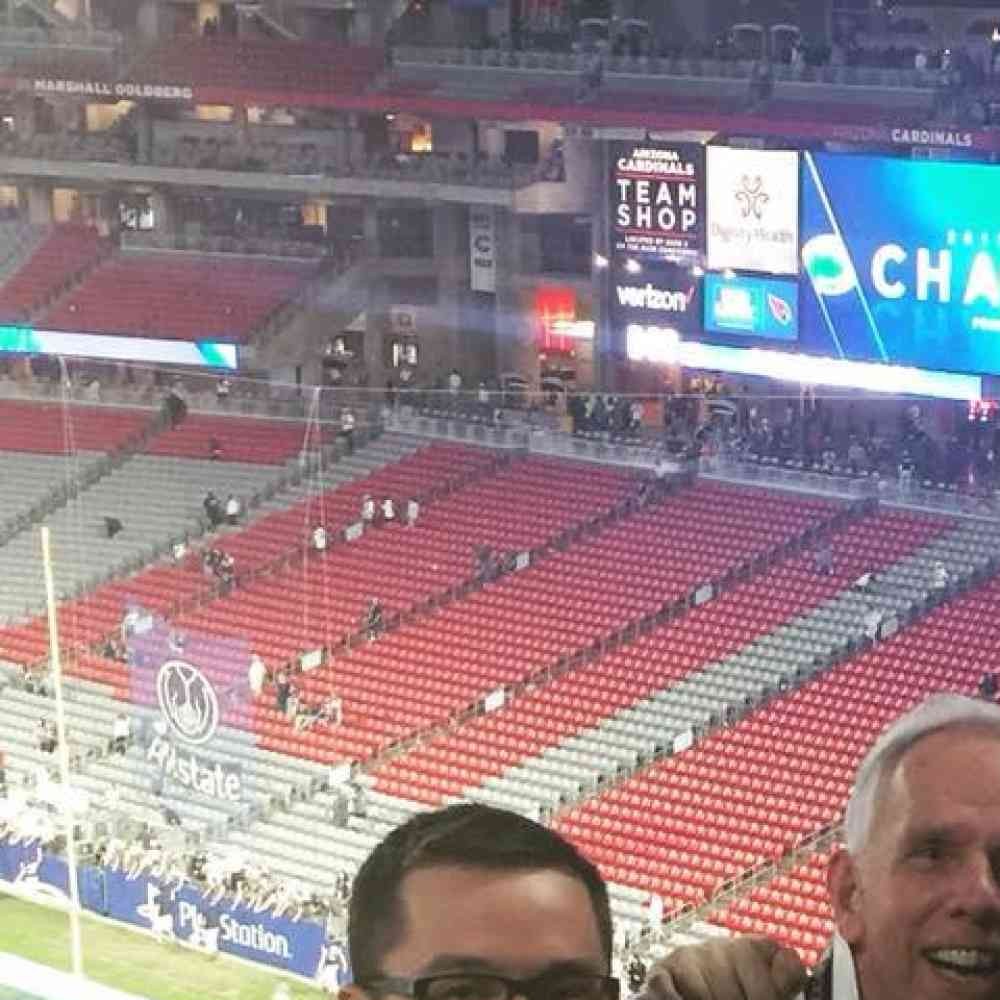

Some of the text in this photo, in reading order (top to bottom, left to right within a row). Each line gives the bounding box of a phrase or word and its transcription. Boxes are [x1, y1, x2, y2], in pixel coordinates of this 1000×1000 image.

[33, 79, 111, 95] MARSHALL
[891, 128, 973, 148] CARDINALS
[616, 157, 695, 176] CARDINALS
[616, 178, 697, 208] TEAM
[616, 203, 697, 232] SHOP
[616, 282, 687, 312] verizon
[178, 901, 289, 957] PlStation
